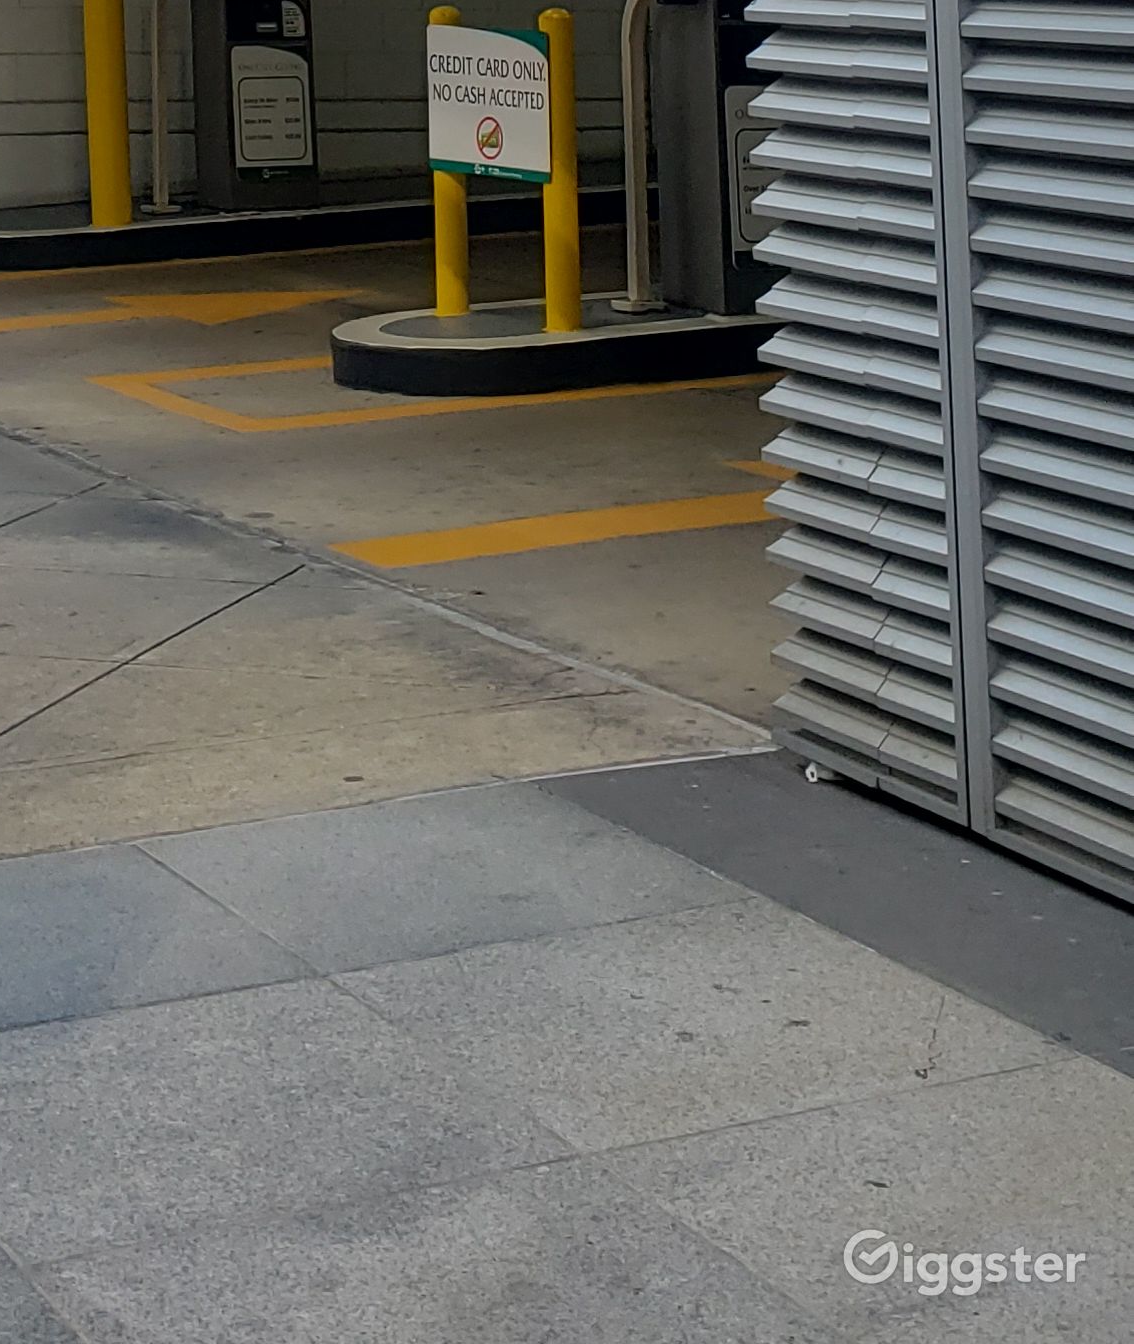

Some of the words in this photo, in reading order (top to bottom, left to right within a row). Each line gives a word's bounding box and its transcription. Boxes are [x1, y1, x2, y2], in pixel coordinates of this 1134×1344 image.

[430, 54, 473, 75] CREDIT
[477, 58, 509, 78] CARD
[433, 84, 451, 102] NO
[455, 85, 486, 105] CASH
[489, 89, 544, 110] ACCEPTED
